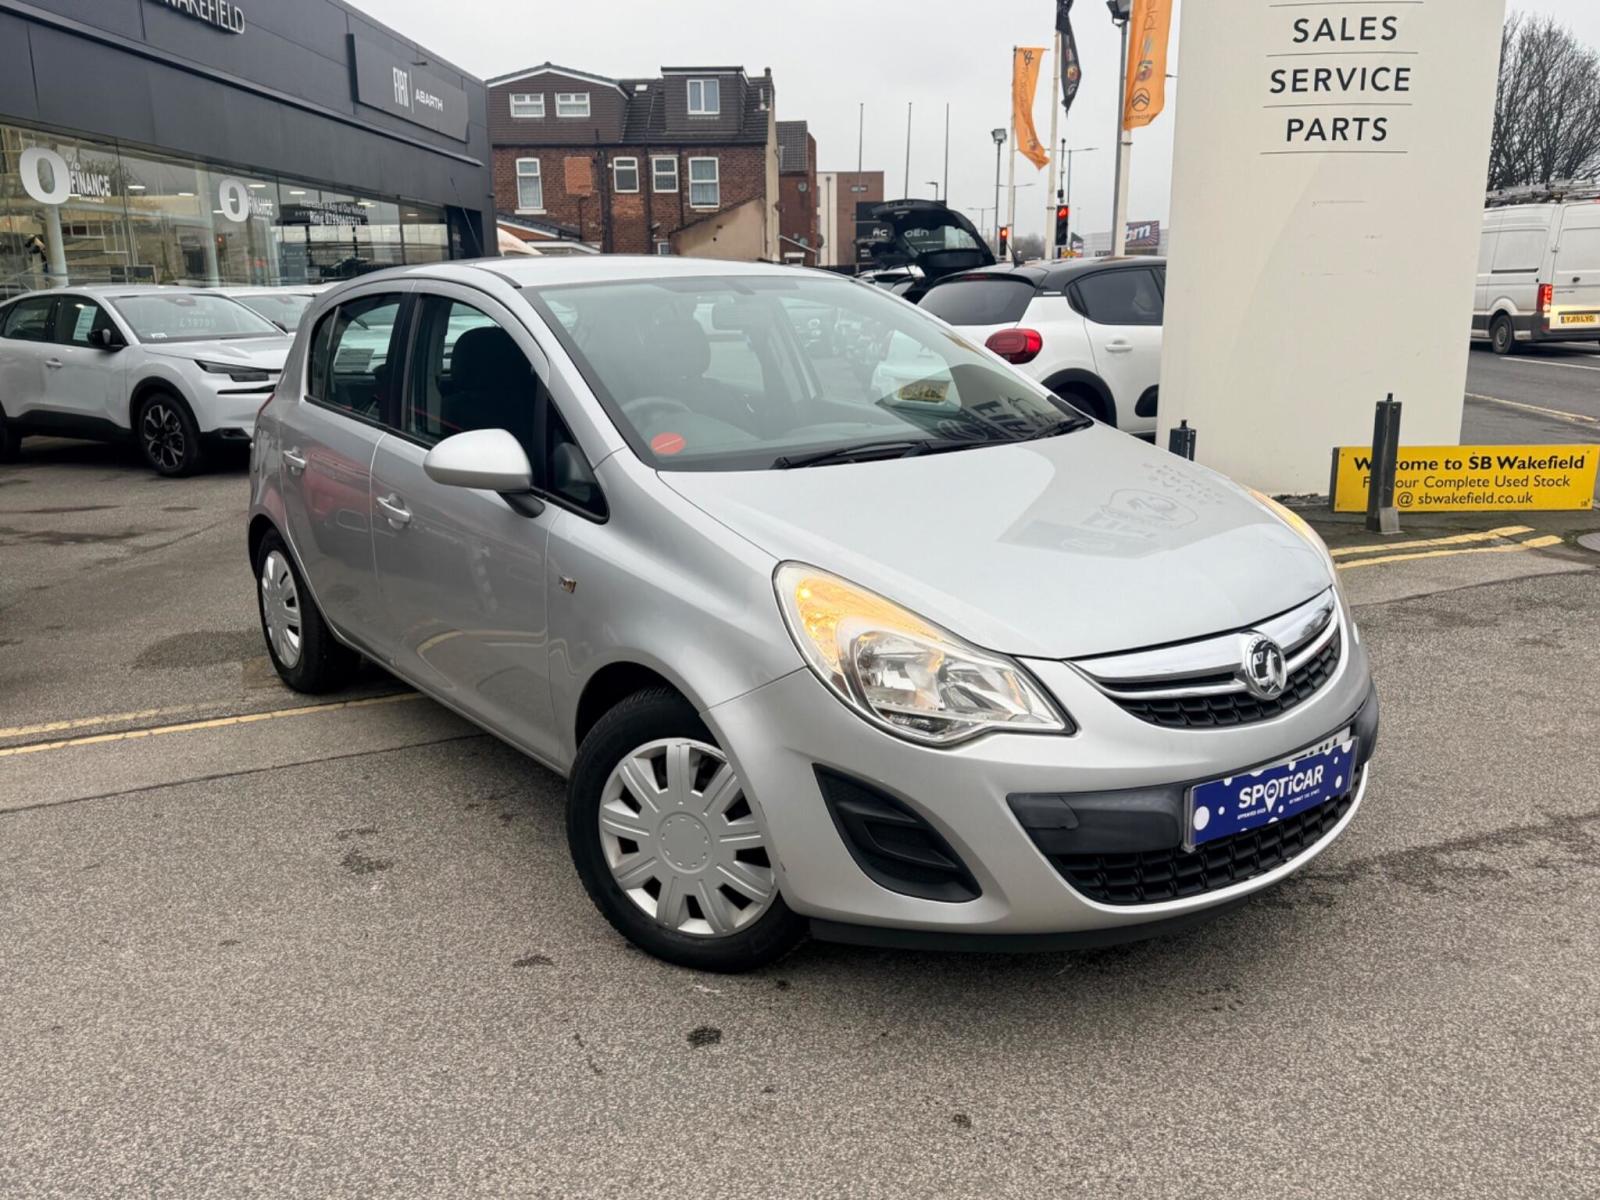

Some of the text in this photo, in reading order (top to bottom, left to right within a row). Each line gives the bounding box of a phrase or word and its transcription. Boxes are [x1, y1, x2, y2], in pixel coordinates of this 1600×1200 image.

[1292, 16, 1398, 43] SALES
[392, 66, 444, 112] FIAT ABARTH
[1270, 66, 1411, 94] SERVICE
[1286, 117, 1388, 142] PARTS
[70, 170, 112, 197] FINANCE
[1354, 455, 1585, 471] Wome to SB Wakefield
[1424, 475, 1490, 491] Complete
[1495, 475, 1529, 487] Used
[1533, 474, 1571, 487] Stock
[1397, 491, 1533, 508] @ sbwakefield.co.uk
